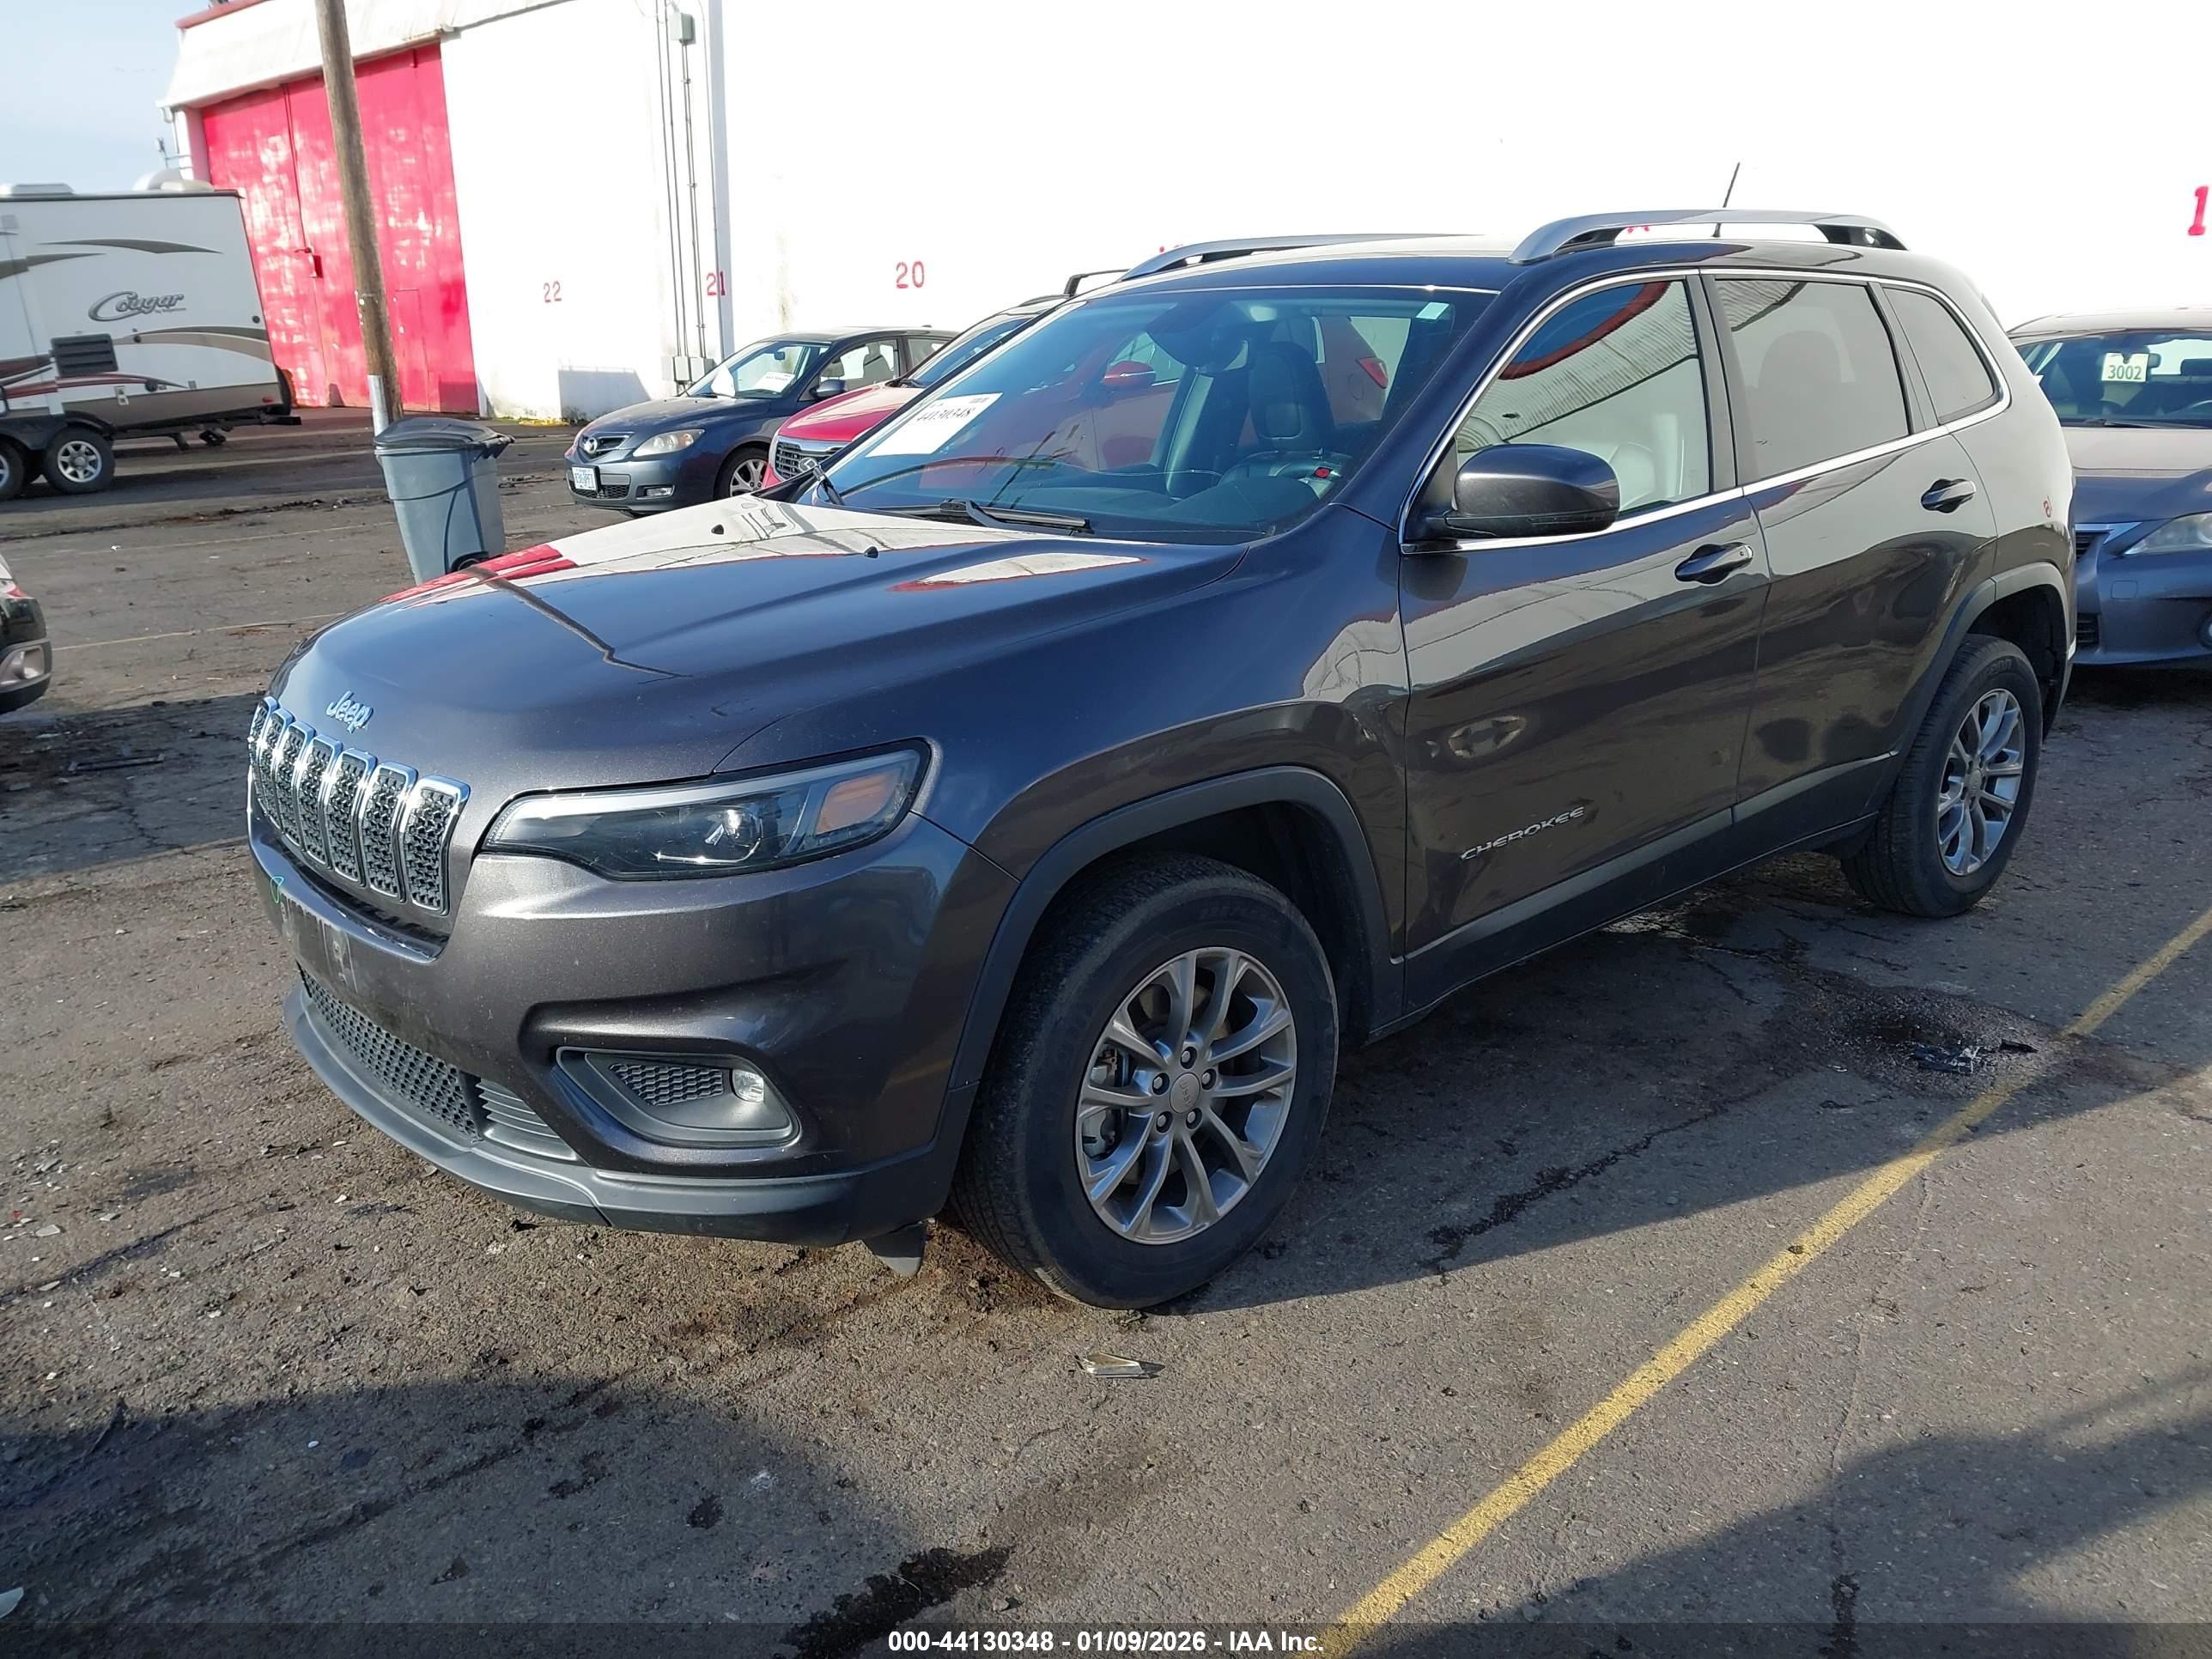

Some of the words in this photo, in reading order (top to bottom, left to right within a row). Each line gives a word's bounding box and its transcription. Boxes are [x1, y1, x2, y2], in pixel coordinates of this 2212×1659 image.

[706, 270, 726, 296] 21
[896, 260, 925, 289] 20
[88, 290, 185, 322] Cougar
[543, 281, 562, 303] 22
[2107, 364, 2142, 380] 3002
[326, 690, 374, 734] Jeep
[1461, 806, 1585, 860] CHEROKEE
